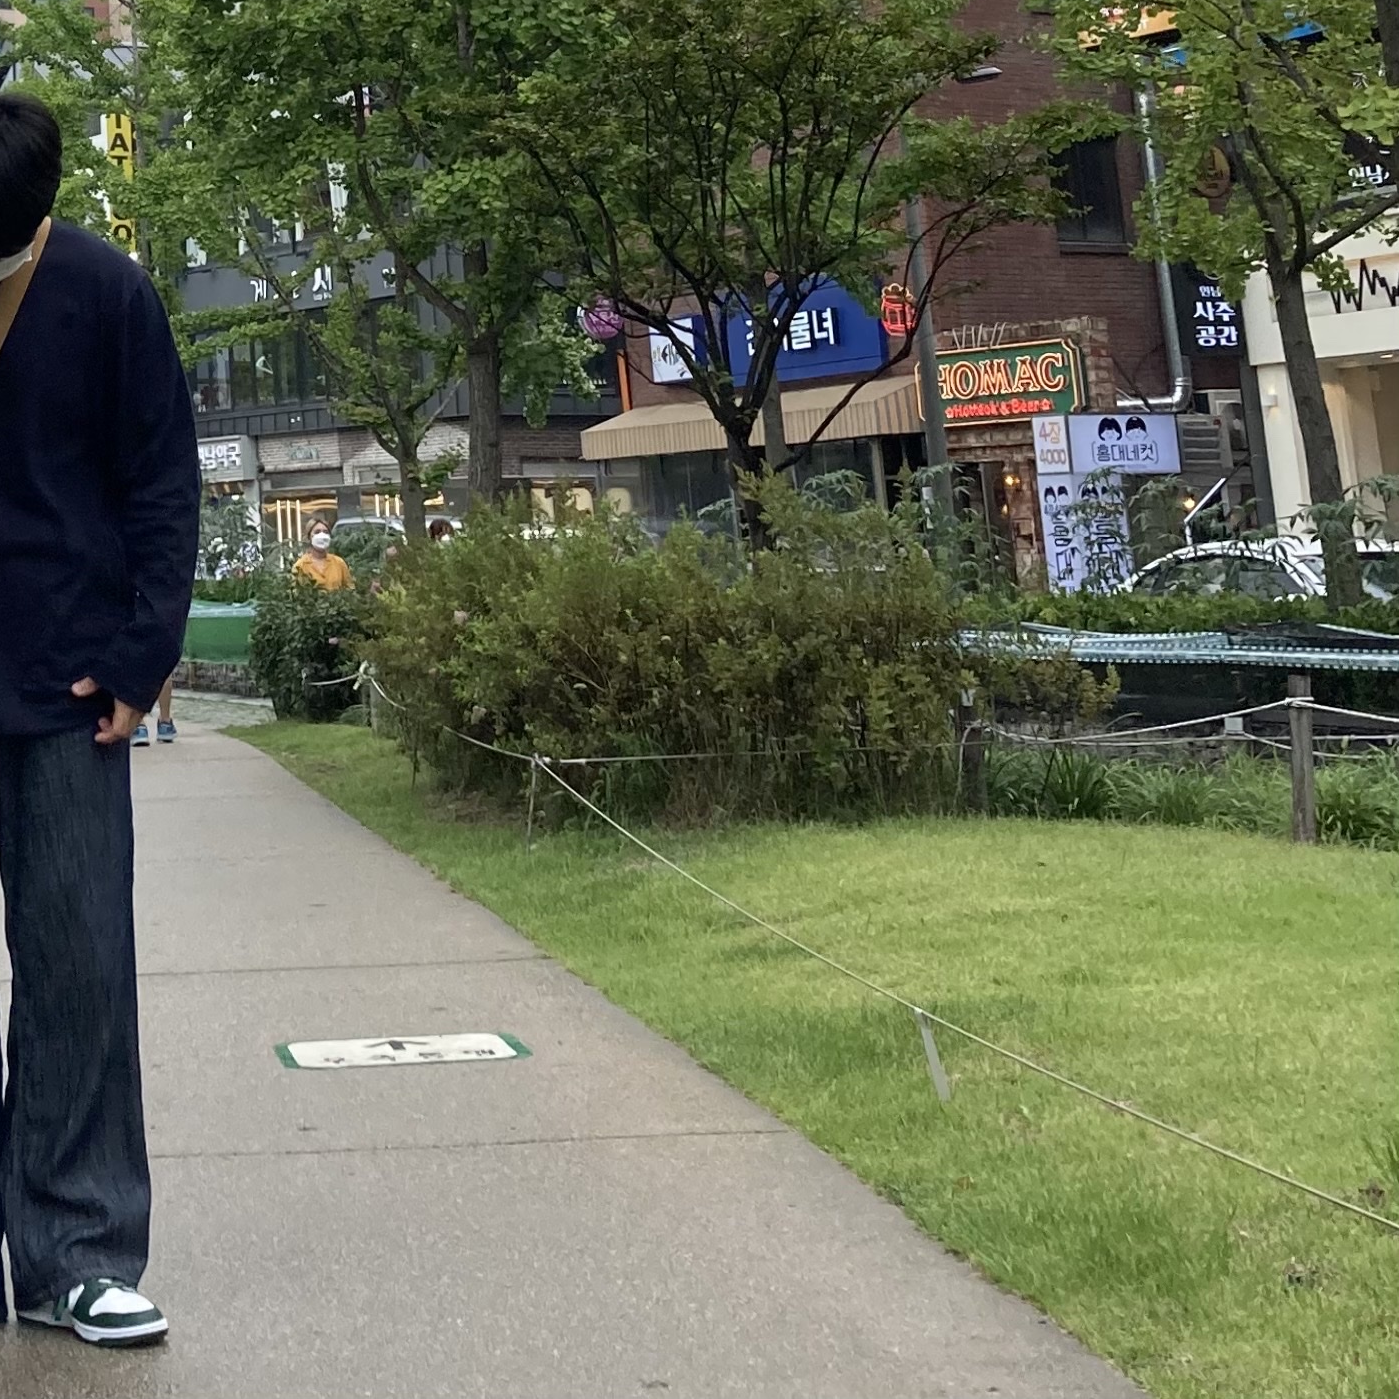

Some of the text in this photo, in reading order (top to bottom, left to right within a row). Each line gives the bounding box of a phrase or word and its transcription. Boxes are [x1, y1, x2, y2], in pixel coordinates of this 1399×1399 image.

[1193, 301, 1236, 322] 사주
[746, 308, 835, 356] 물녀
[1195, 325, 1239, 347] 공간
[1011, 398, 1040, 414] Beer
[1039, 448, 1067, 466] 4000
